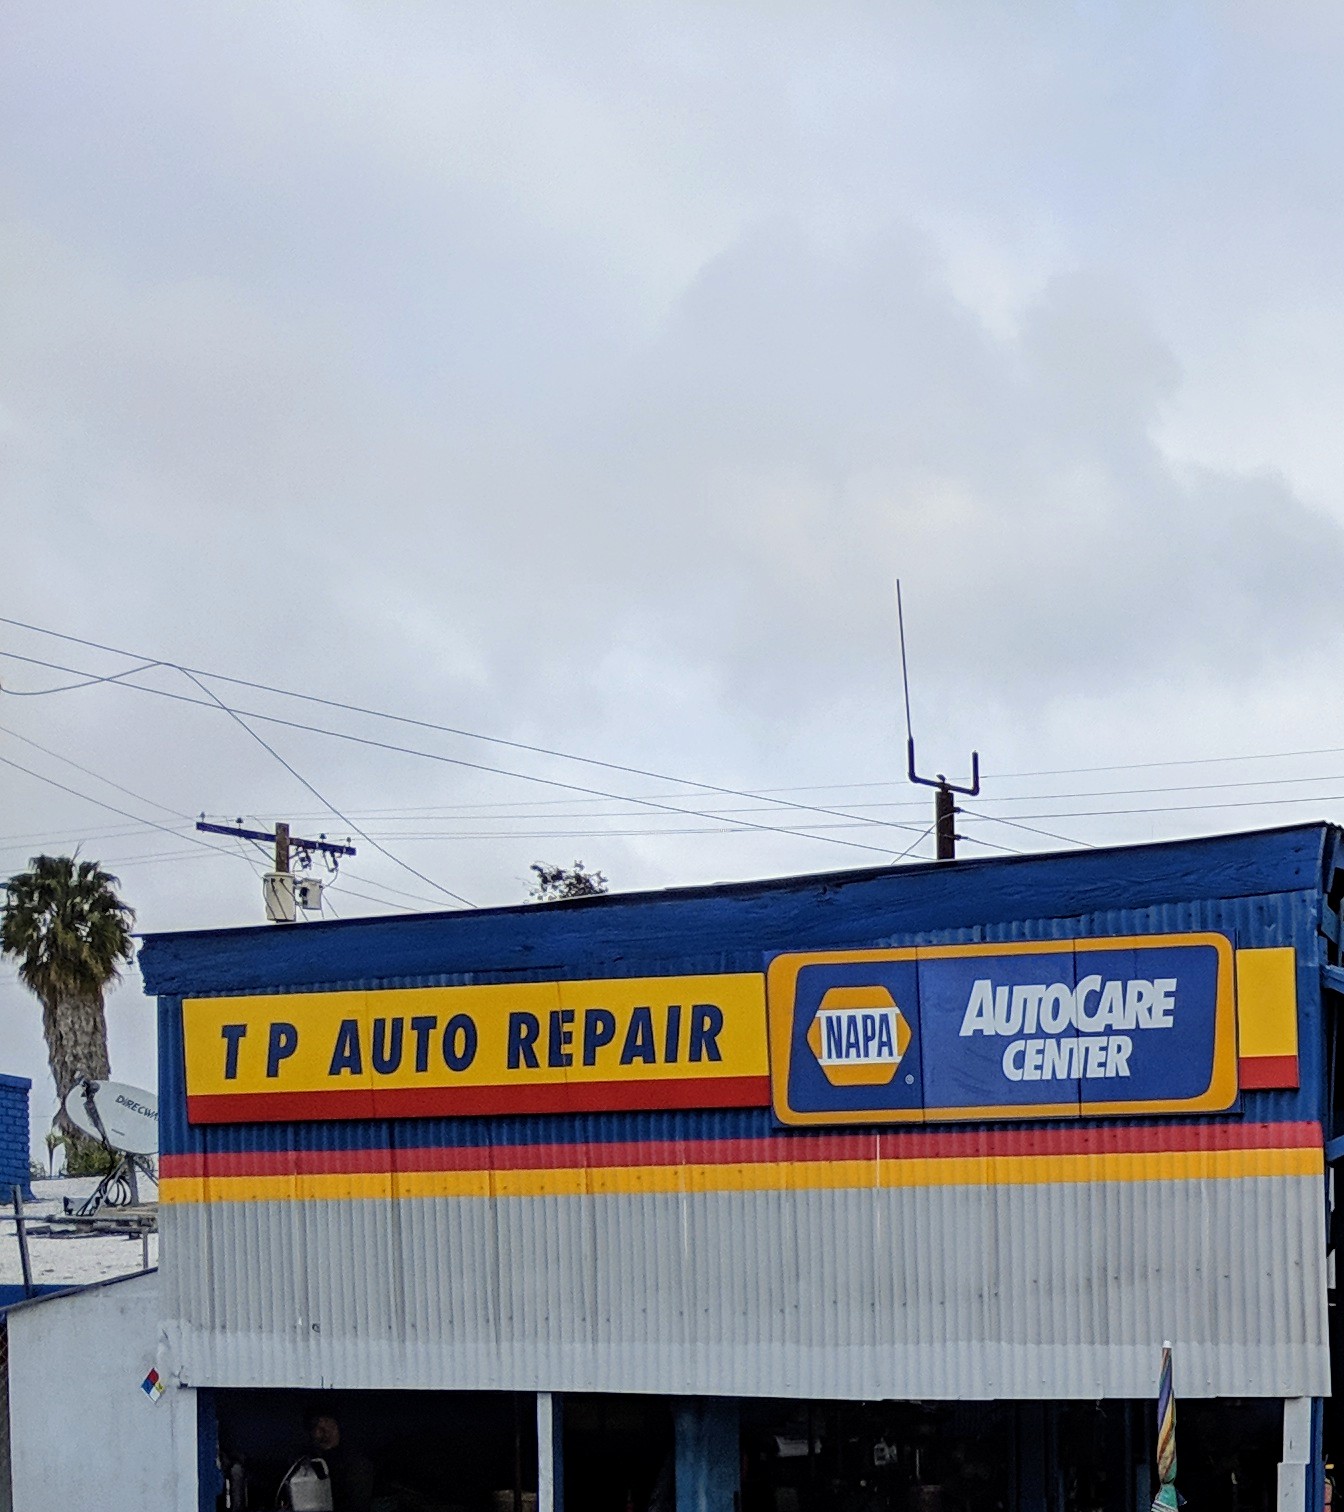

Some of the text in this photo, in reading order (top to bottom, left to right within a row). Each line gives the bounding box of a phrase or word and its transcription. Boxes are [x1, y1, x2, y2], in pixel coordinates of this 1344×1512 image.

[220, 1003, 724, 1080] T P AUTO REPAIR
[825, 1012, 895, 1060] NAPA
[1002, 1035, 1133, 1082] CENTER
